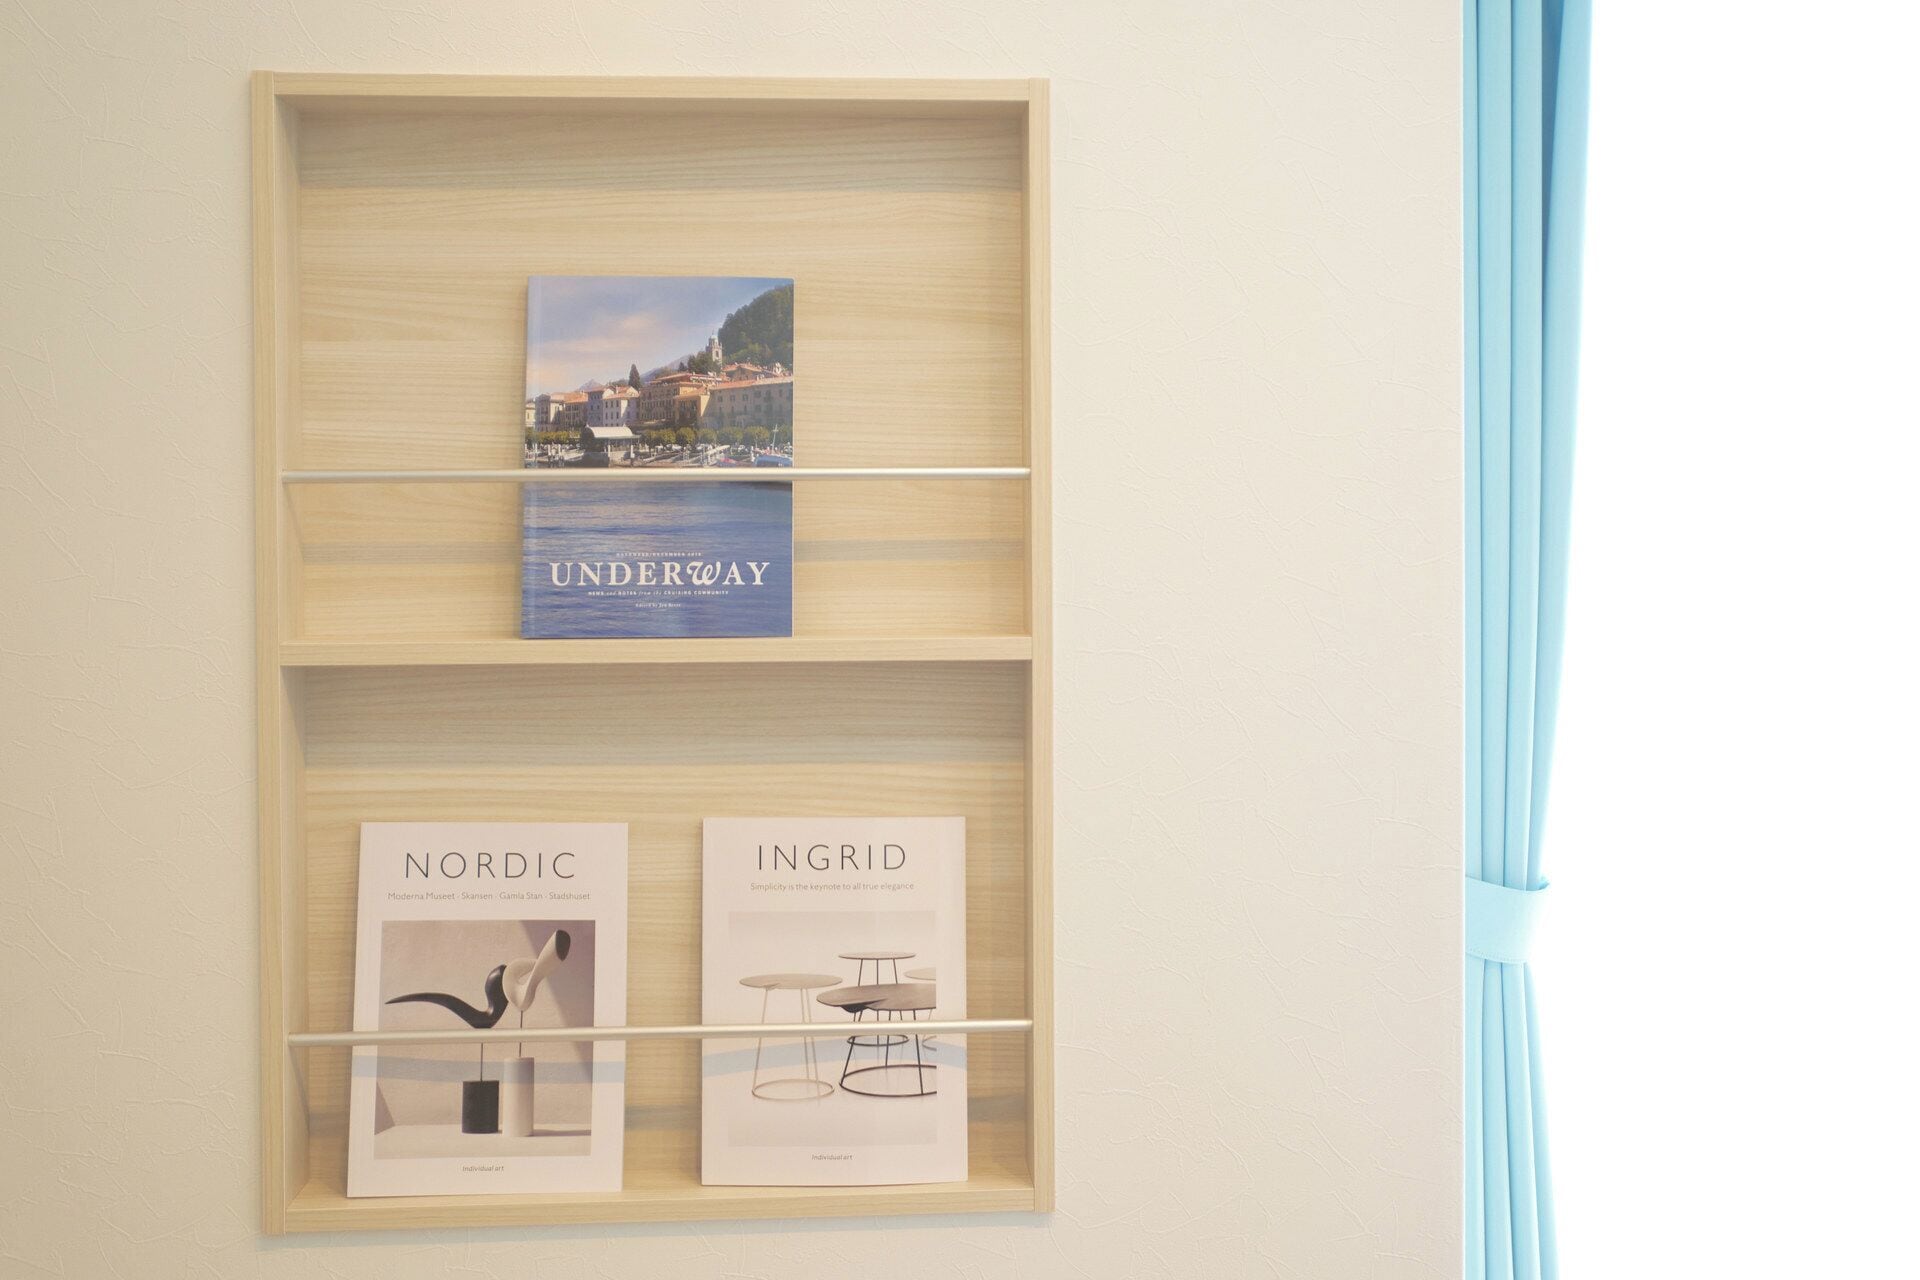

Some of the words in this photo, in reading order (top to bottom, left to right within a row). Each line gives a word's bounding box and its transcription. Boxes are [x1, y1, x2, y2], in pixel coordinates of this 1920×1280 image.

[549, 560, 771, 586] UNDERWAY
[405, 851, 576, 879] NORDIC
[758, 843, 907, 871] INGRID
[387, 891, 424, 901] Moderna
[426, 891, 455, 901] Museet
[461, 891, 493, 901] Skansen
[499, 891, 525, 901] Gamla
[526, 891, 543, 901] Stan
[549, 891, 591, 901] Stadshuset
[750, 882, 787, 892] Simplicity
[789, 882, 795, 890] is
[796, 881, 808, 890] the
[810, 881, 841, 892] keynote
[842, 882, 851, 890] to
[852, 881, 861, 890] all
[862, 882, 879, 890] true
[880, 881, 915, 891] elegance
